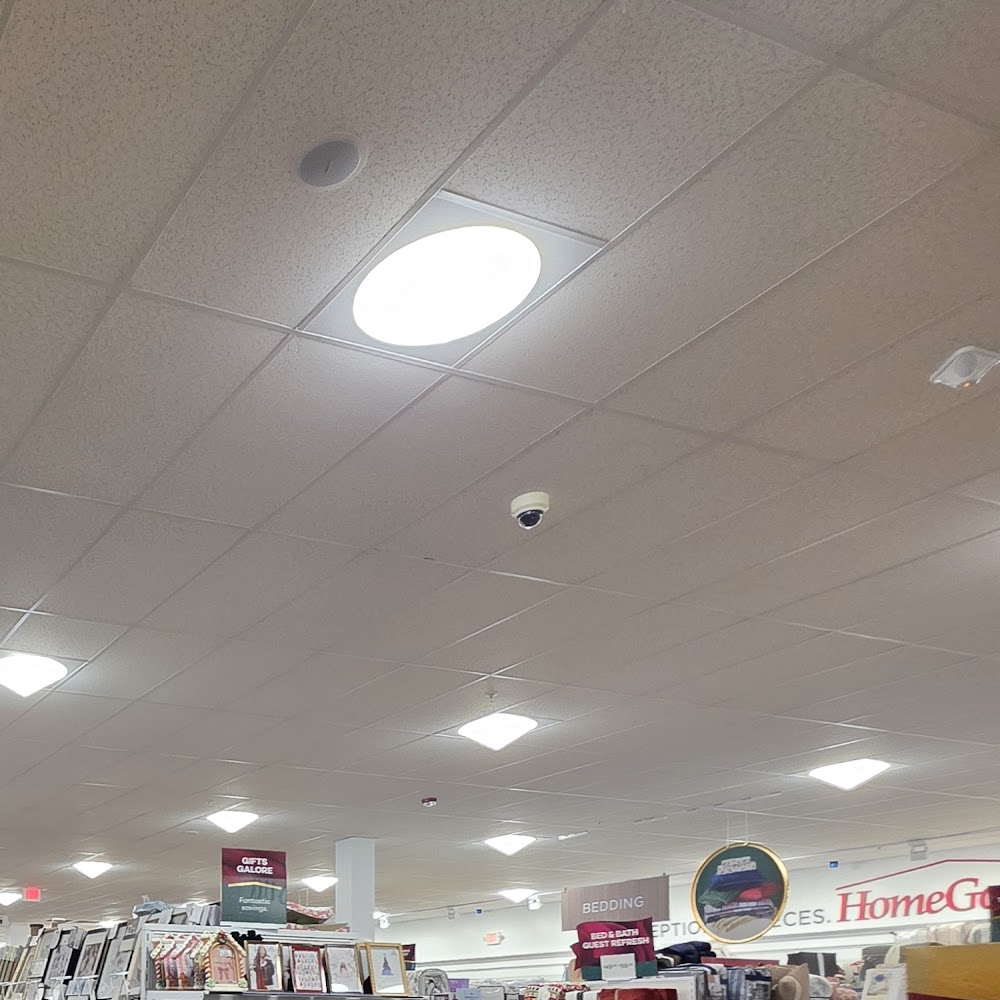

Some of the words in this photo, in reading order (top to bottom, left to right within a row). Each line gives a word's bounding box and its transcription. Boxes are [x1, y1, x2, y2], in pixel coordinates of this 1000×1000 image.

[241, 856, 268, 866] GIFTS
[236, 865, 273, 875] GALORE
[239, 896, 271, 905] Fantastic
[582, 896, 644, 914] BEDDING
[590, 931, 607, 940] BED
[608, 930, 615, 938] &
[615, 928, 639, 938] BATH
[652, 922, 706, 937] EPTIO
[582, 940, 609, 949] GUEST
[611, 937, 650, 947] REFRESH
